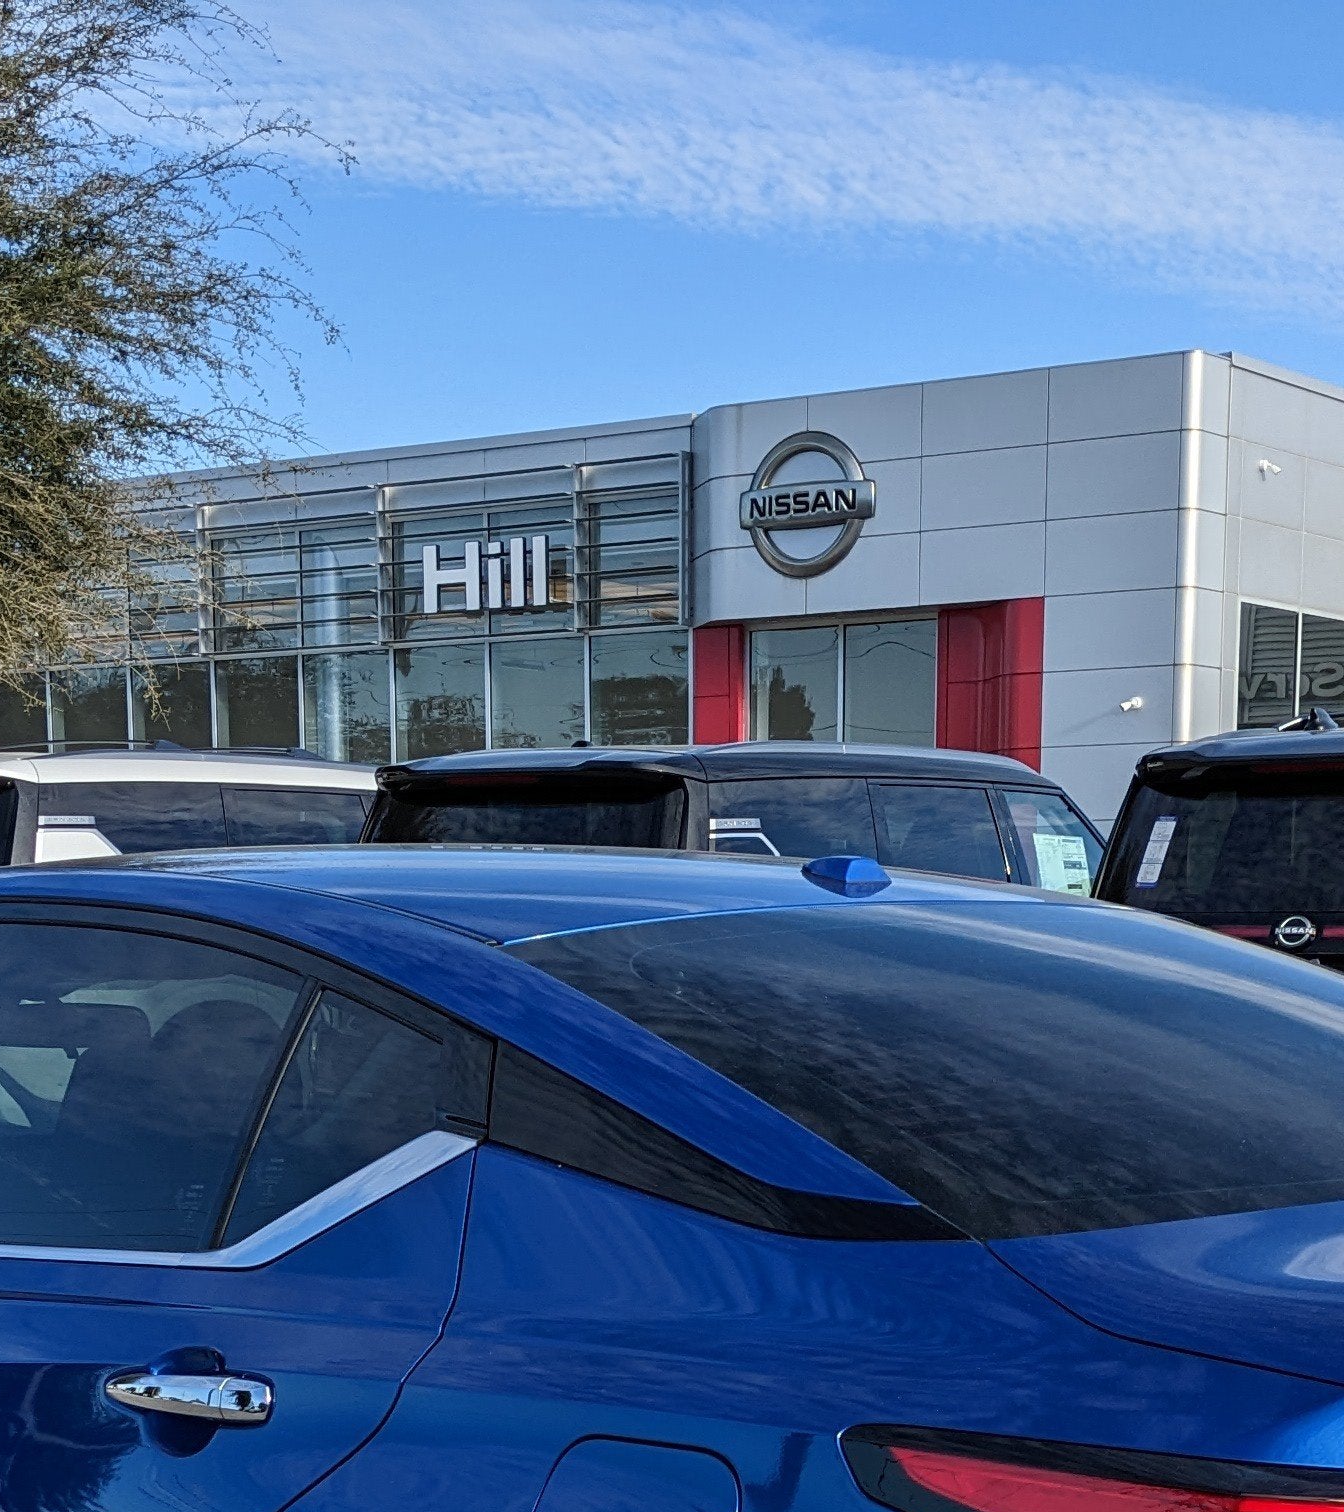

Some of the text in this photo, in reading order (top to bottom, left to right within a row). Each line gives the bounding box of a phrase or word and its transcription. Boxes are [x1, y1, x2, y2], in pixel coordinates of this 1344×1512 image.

[748, 489, 858, 520] NISSAN
[422, 534, 549, 614] Hill
[1274, 927, 1316, 936] NISSAN
